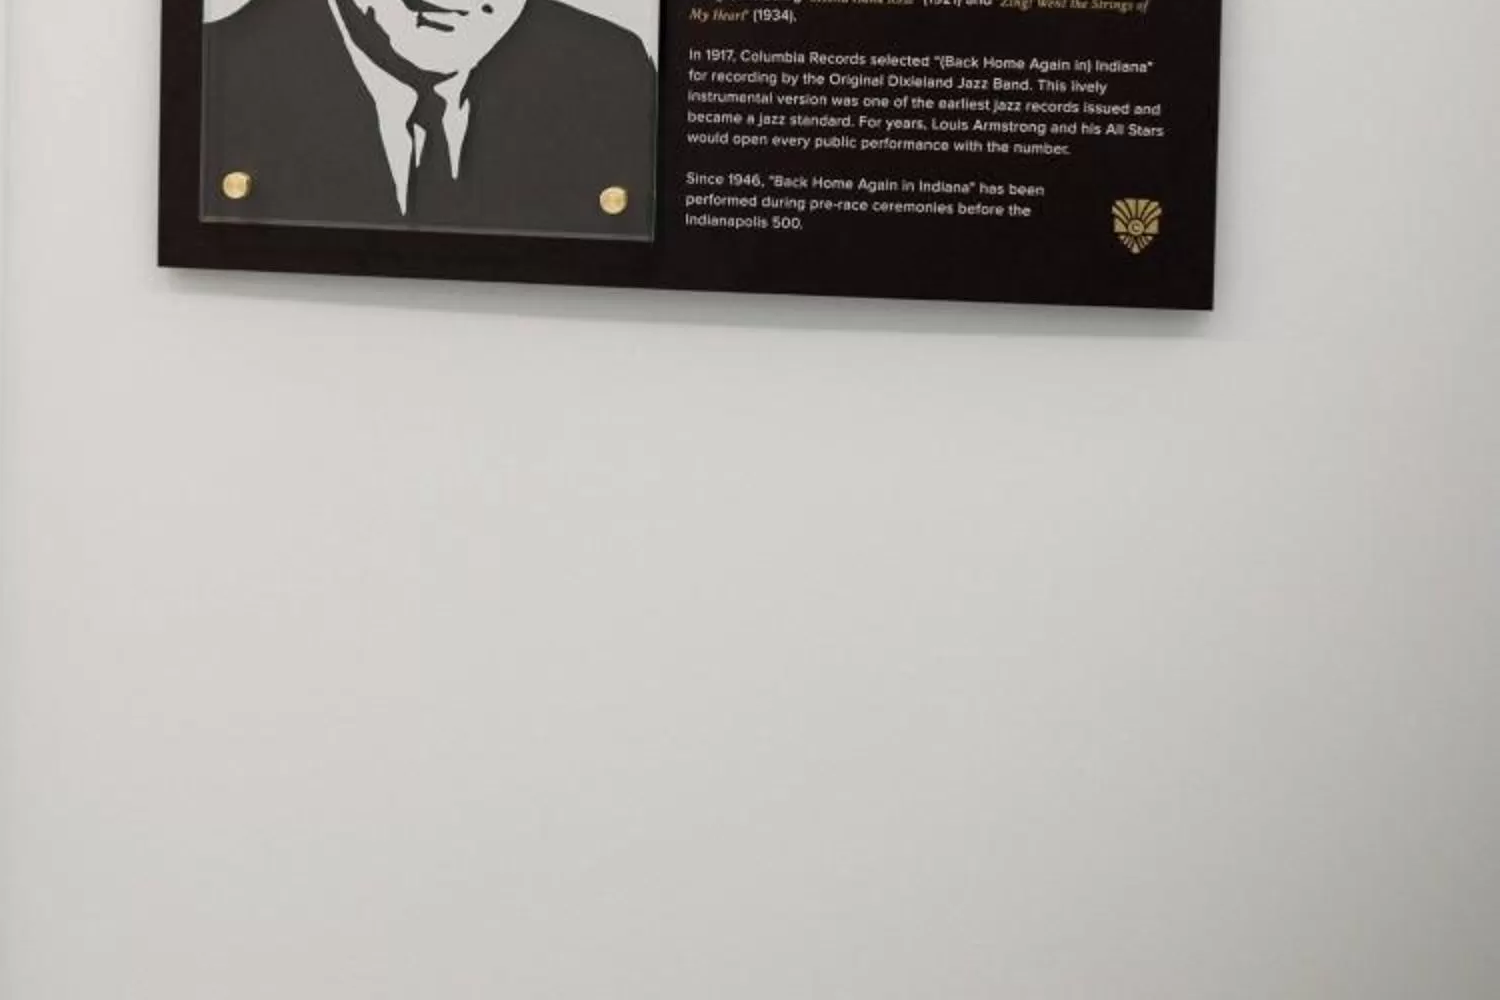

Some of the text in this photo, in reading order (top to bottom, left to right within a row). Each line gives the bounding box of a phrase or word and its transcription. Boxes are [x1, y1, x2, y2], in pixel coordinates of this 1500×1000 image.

[688, 7, 797, 24] My Heart" (1934).
[688, 47, 702, 60] In
[739, 48, 805, 63] Columbia
[808, 51, 867, 65] Records
[869, 53, 931, 67] selected
[982, 55, 1026, 69] Home
[1028, 57, 1071, 72] Again
[1095, 59, 1154, 73] Indiana"
[687, 67, 1108, 95] for recording by the Original Dixieland Jazz Band. This lively
[687, 89, 1161, 116] instrumental version was one of the earliest jazz records issued and
[687, 109, 1165, 136] became a jazz standard. For years, Louis Armstrong and his All Stars
[686, 131, 730, 144] would
[731, 134, 769, 147] open
[771, 135, 811, 150] every
[814, 135, 857, 149] public
[860, 137, 950, 151] performance
[953, 139, 984, 152] with
[986, 140, 1010, 152] the
[685, 171, 725, 185] Since
[768, 174, 809, 188] "Back
[811, 175, 854, 189] Home
[857, 177, 899, 193] Again
[901, 179, 915, 192] in
[918, 179, 976, 193] Indiana"
[979, 182, 1005, 195] has
[1008, 183, 1045, 196] been
[685, 192, 1032, 216] performed during pre-race ceremonies before the
[684, 212, 769, 229] Indianapolis
